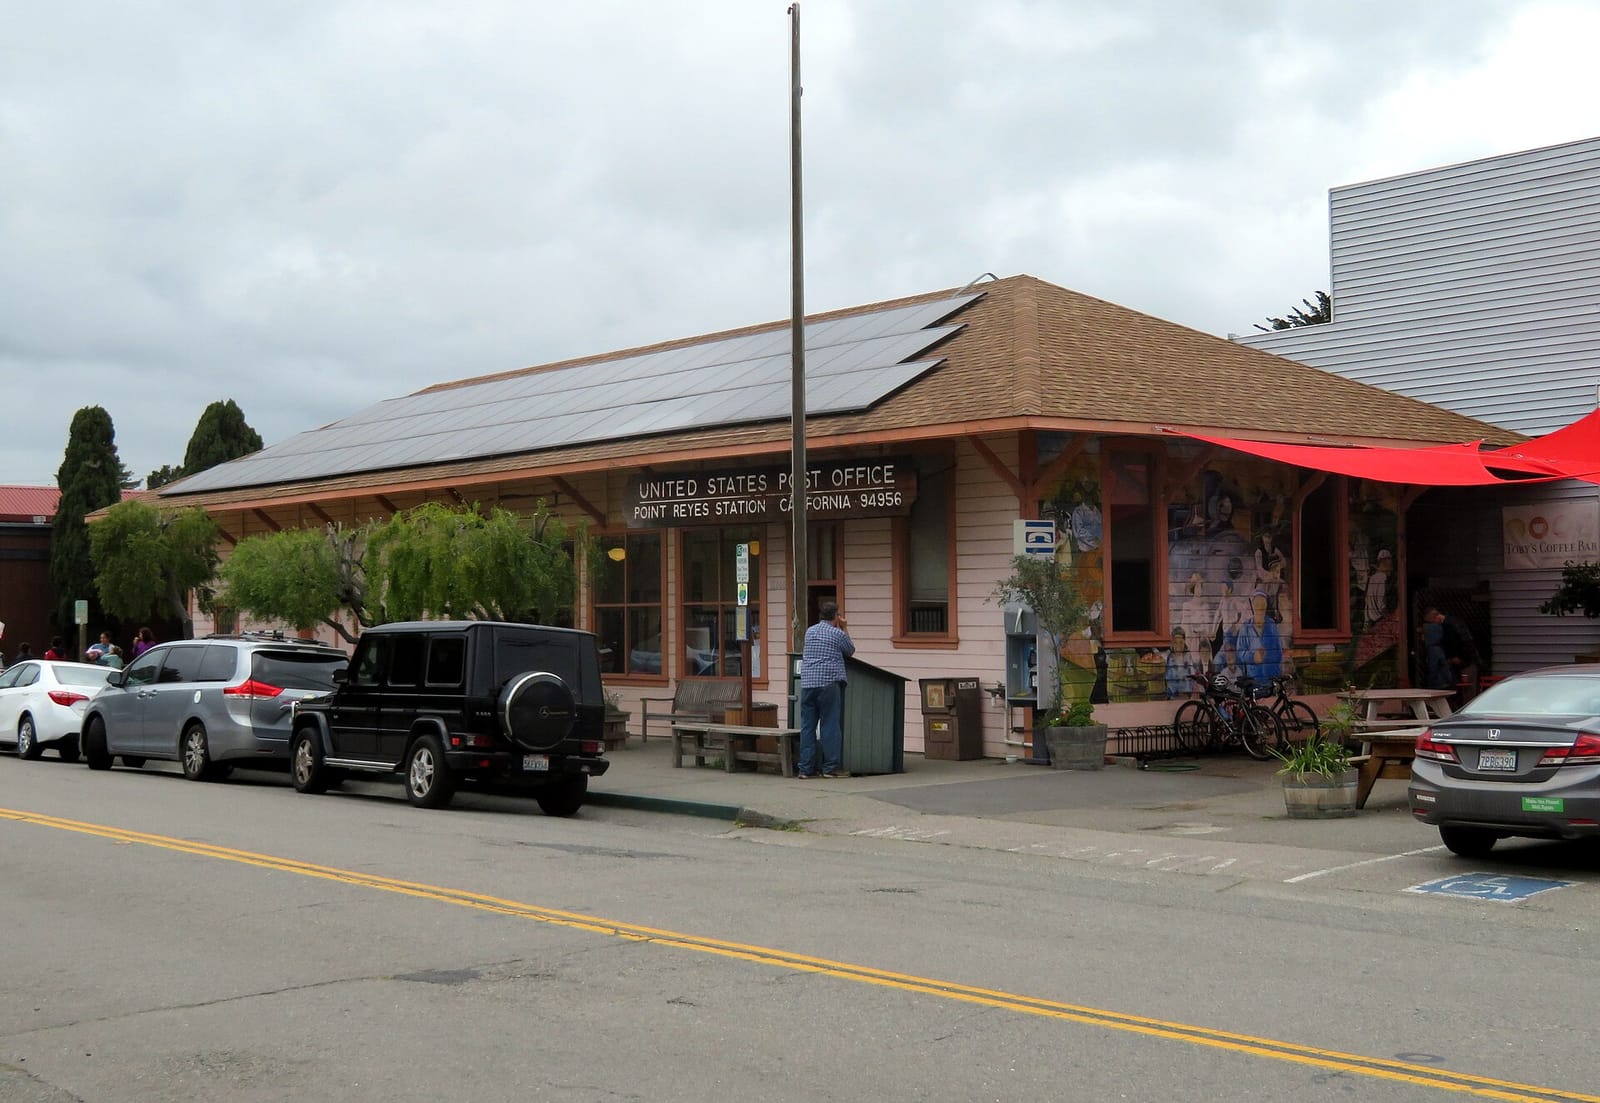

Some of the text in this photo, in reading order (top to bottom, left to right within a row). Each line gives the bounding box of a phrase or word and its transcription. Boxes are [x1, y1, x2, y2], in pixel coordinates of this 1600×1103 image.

[639, 479, 698, 499] UNITED
[707, 474, 768, 495] STATES
[831, 465, 895, 487] OFFICE
[634, 491, 902, 519] POINT REYES STATION CAFORNIA 94956
[1539, 542, 1576, 553] COFFEE
